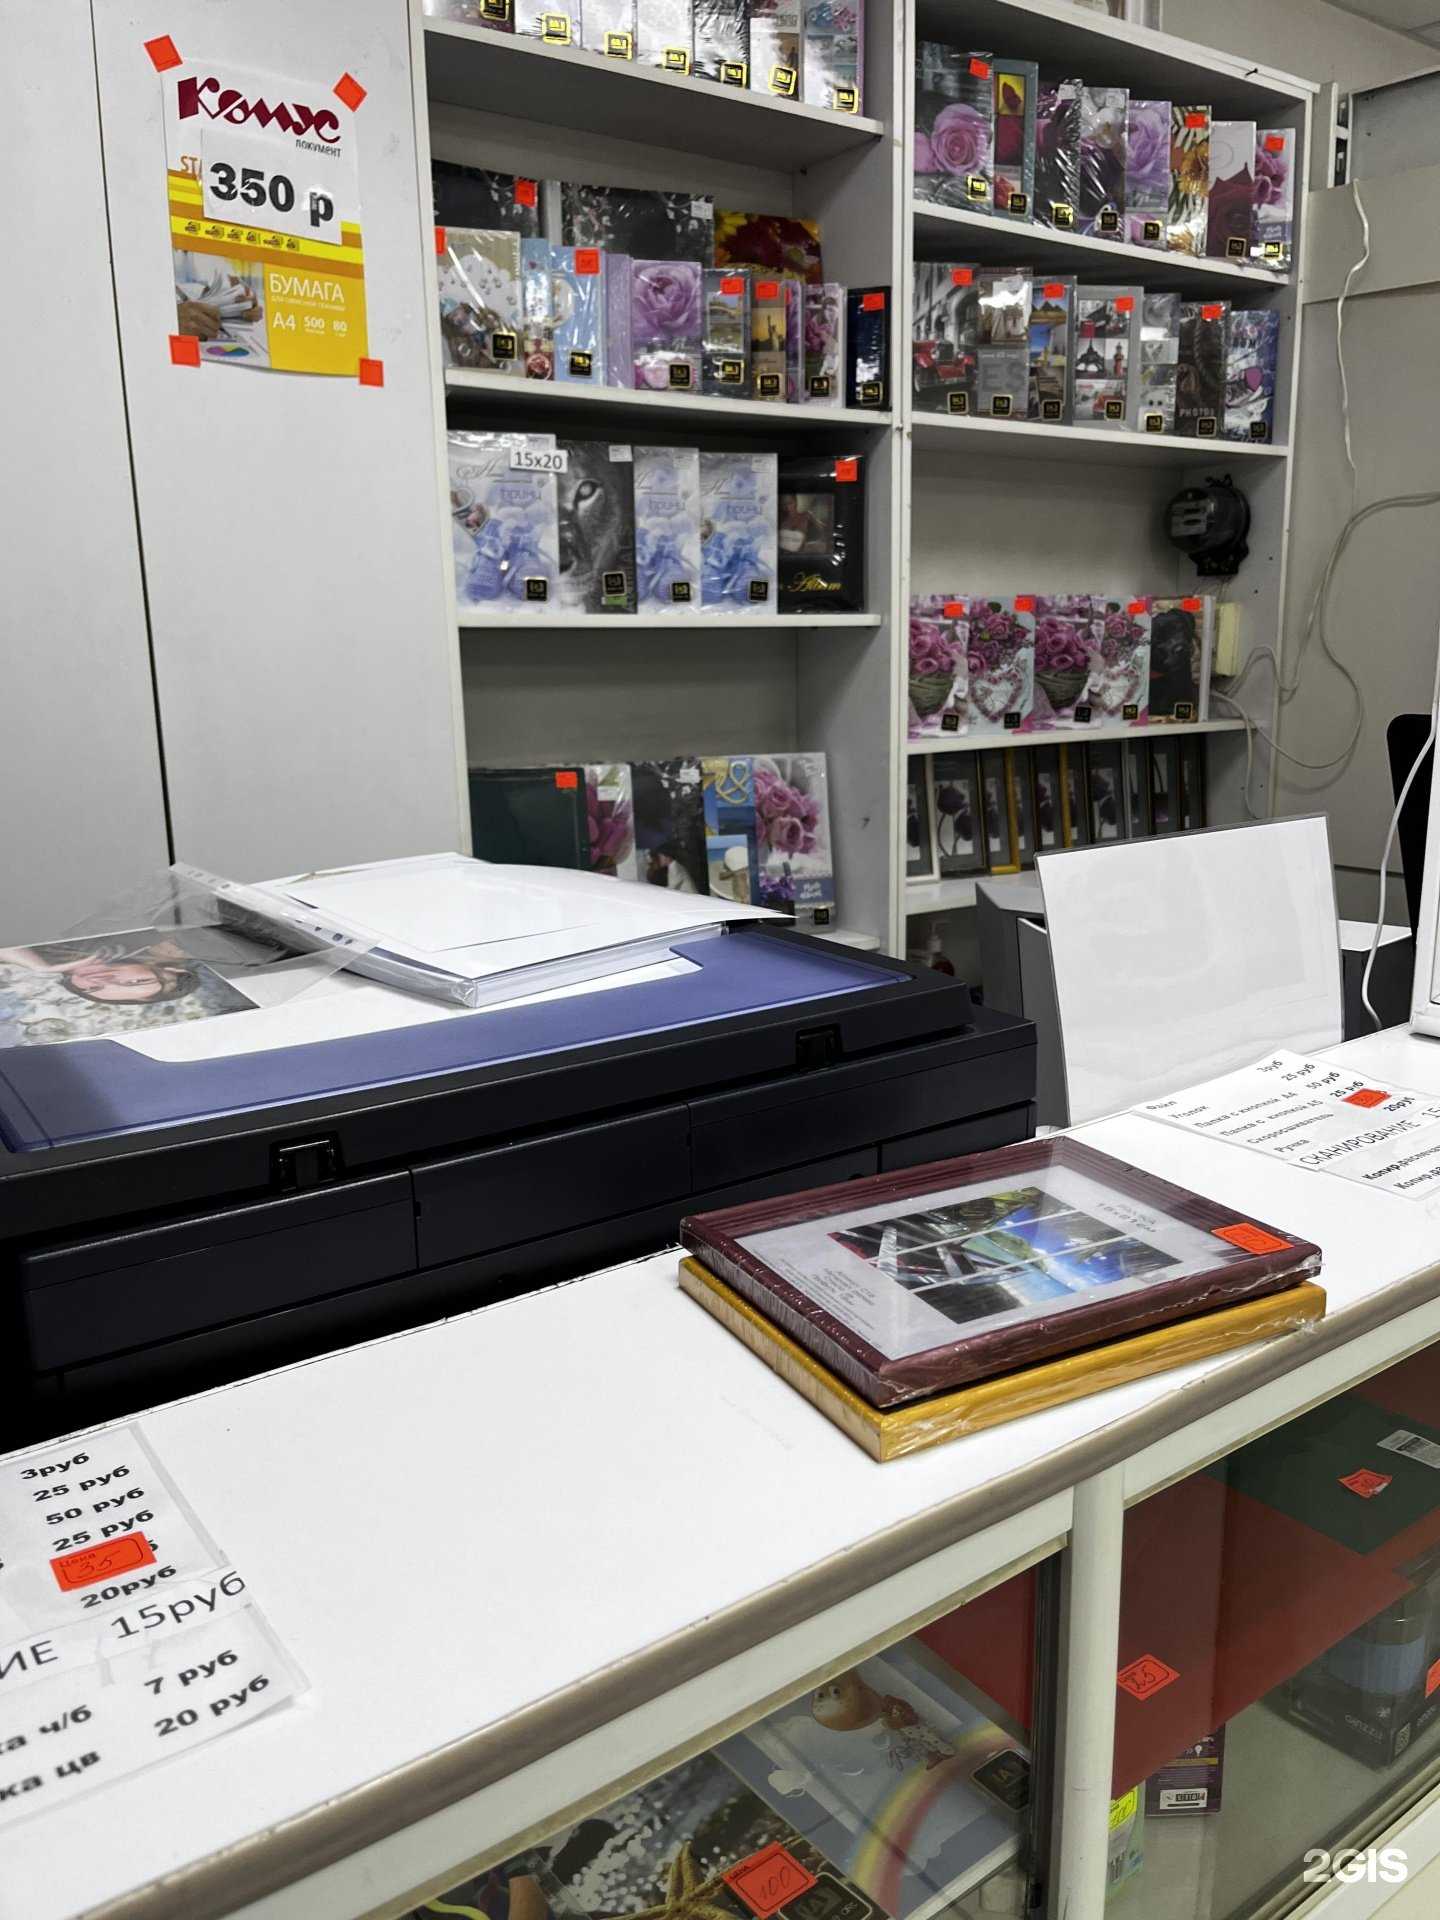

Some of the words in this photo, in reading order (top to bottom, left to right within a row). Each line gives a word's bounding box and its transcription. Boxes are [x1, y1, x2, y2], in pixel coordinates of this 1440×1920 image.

[177, 76, 342, 144] Комус
[210, 162, 295, 212] 350
[309, 192, 334, 227] р
[269, 273, 345, 303] БУМАГА
[304, 315, 325, 329] 500
[1281, 1072, 1298, 1082] 25
[1296, 1063, 1316, 1078] руб
[1321, 1071, 1340, 1086] руб
[1330, 1088, 1347, 1098] 25
[1193, 1114, 1231, 1129] Папка
[1220, 1122, 1256, 1137] Папка
[1300, 1119, 1421, 1166] СКАНИРОВАНИЕ
[20, 1453, 90, 1480] 3руб
[33, 1483, 70, 1502] 25
[79, 1465, 131, 1493] руб
[46, 1507, 82, 1526] 50
[92, 1487, 145, 1515] руб
[52, 1531, 91, 1552] 25
[100, 1509, 155, 1538] руб
[80, 1565, 177, 1608] 20руб
[110, 1570, 246, 1640] 15руб
[144, 1677, 165, 1695] 7
[178, 1650, 239, 1688] руб
[38, 1704, 92, 1734] ч/б
[154, 1710, 200, 1738] 20
[210, 1675, 270, 1716] руб
[55, 1751, 101, 1778] цв
